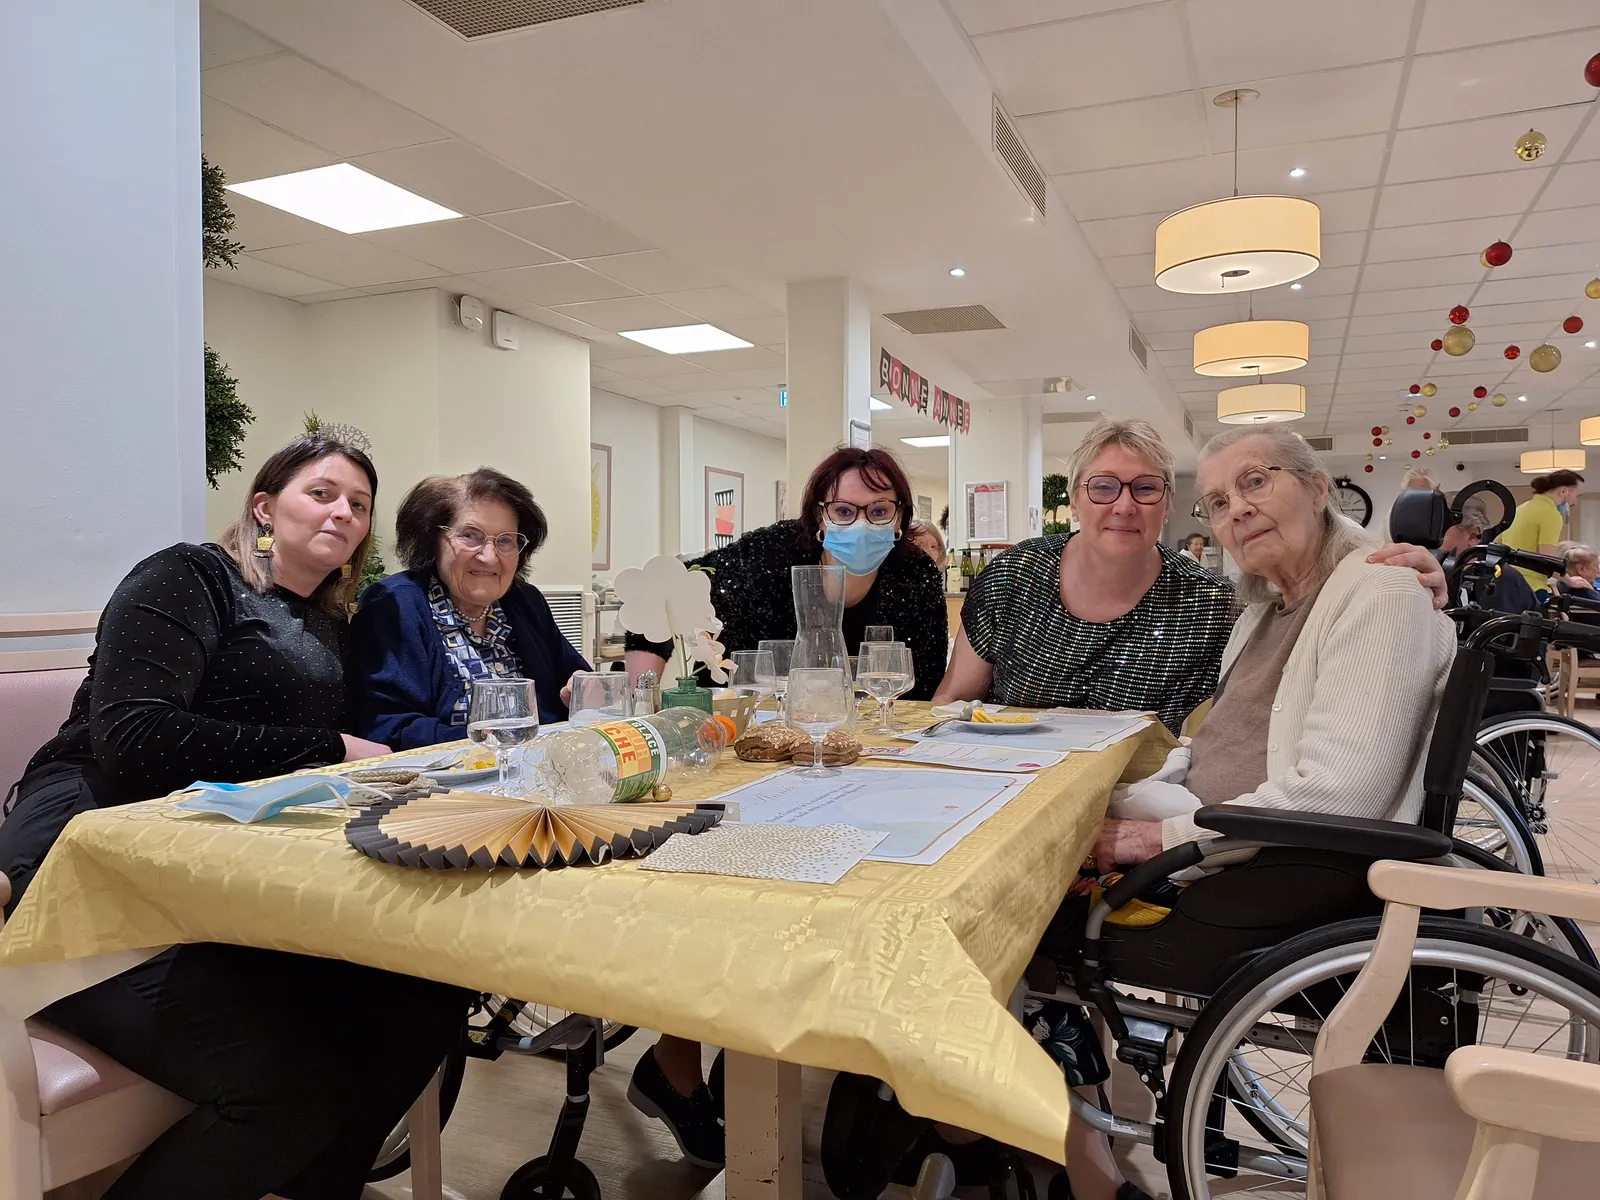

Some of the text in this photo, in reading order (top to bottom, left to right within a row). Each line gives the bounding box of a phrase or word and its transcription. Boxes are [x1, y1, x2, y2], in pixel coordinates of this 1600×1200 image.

[881, 357, 969, 427] BONNE ANNEE
[602, 726, 637, 764] CHE
[631, 721, 660, 757] GLACE
